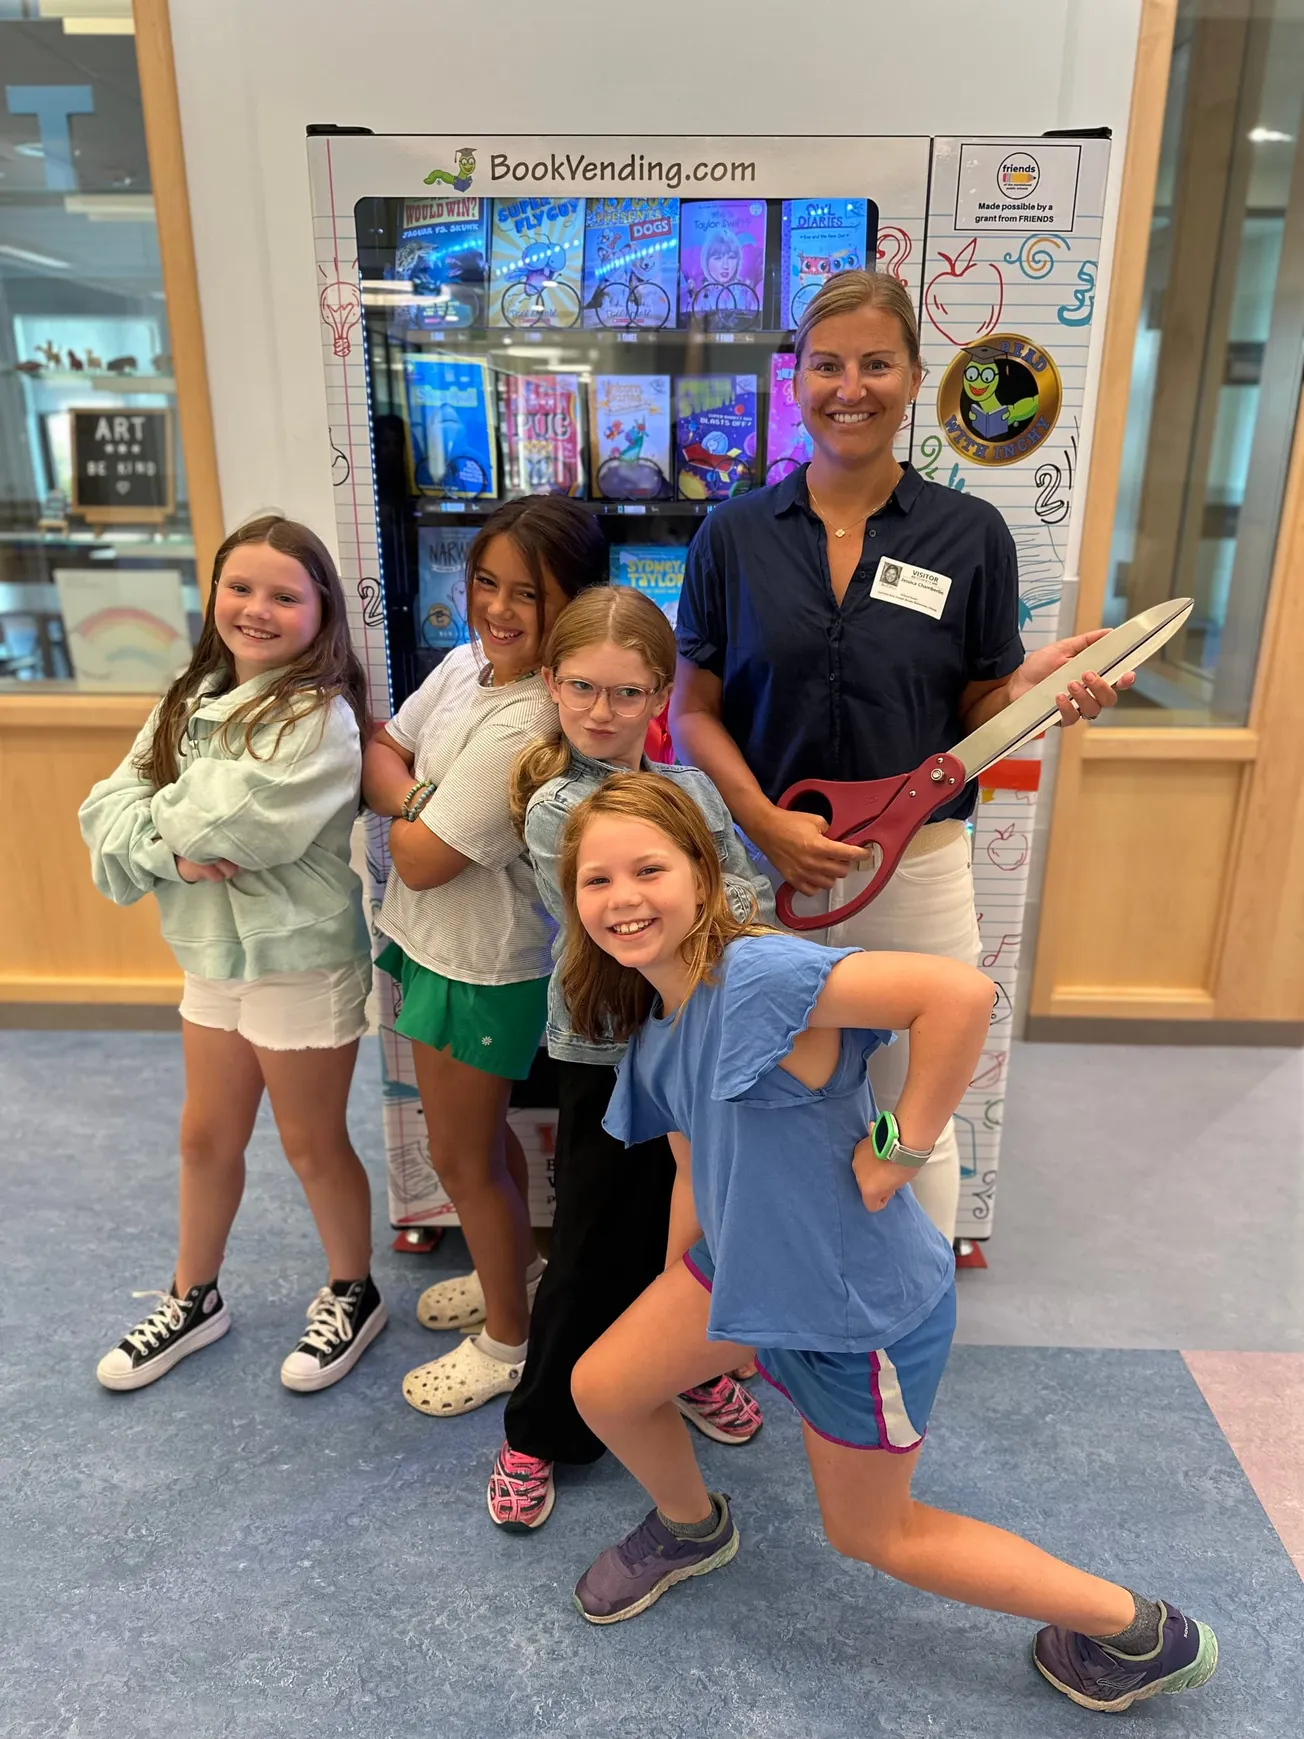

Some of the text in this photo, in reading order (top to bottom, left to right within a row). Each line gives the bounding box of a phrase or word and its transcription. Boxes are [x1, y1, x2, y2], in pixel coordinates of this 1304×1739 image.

[490, 154, 756, 189] BookVending.com
[1002, 164, 1036, 173] friends
[405, 197, 478, 227] WOULD WIN?
[514, 210, 545, 234] FLY
[546, 197, 580, 222] GUY
[1001, 203, 1035, 211] possible
[1036, 203, 1047, 212] by
[694, 220, 720, 232] Taylor
[798, 216, 844, 228] DIARIES
[975, 215, 997, 224] grant
[1019, 215, 1055, 223] FRIENDS
[632, 220, 669, 238] DOGS
[1000, 340, 1048, 373] READ
[95, 416, 147, 441] ART
[512, 412, 570, 441] PUG
[944, 414, 1050, 460] WITH INCHY
[86, 460, 158, 477] BE KIND
[912, 569, 939, 583] VISITOR
